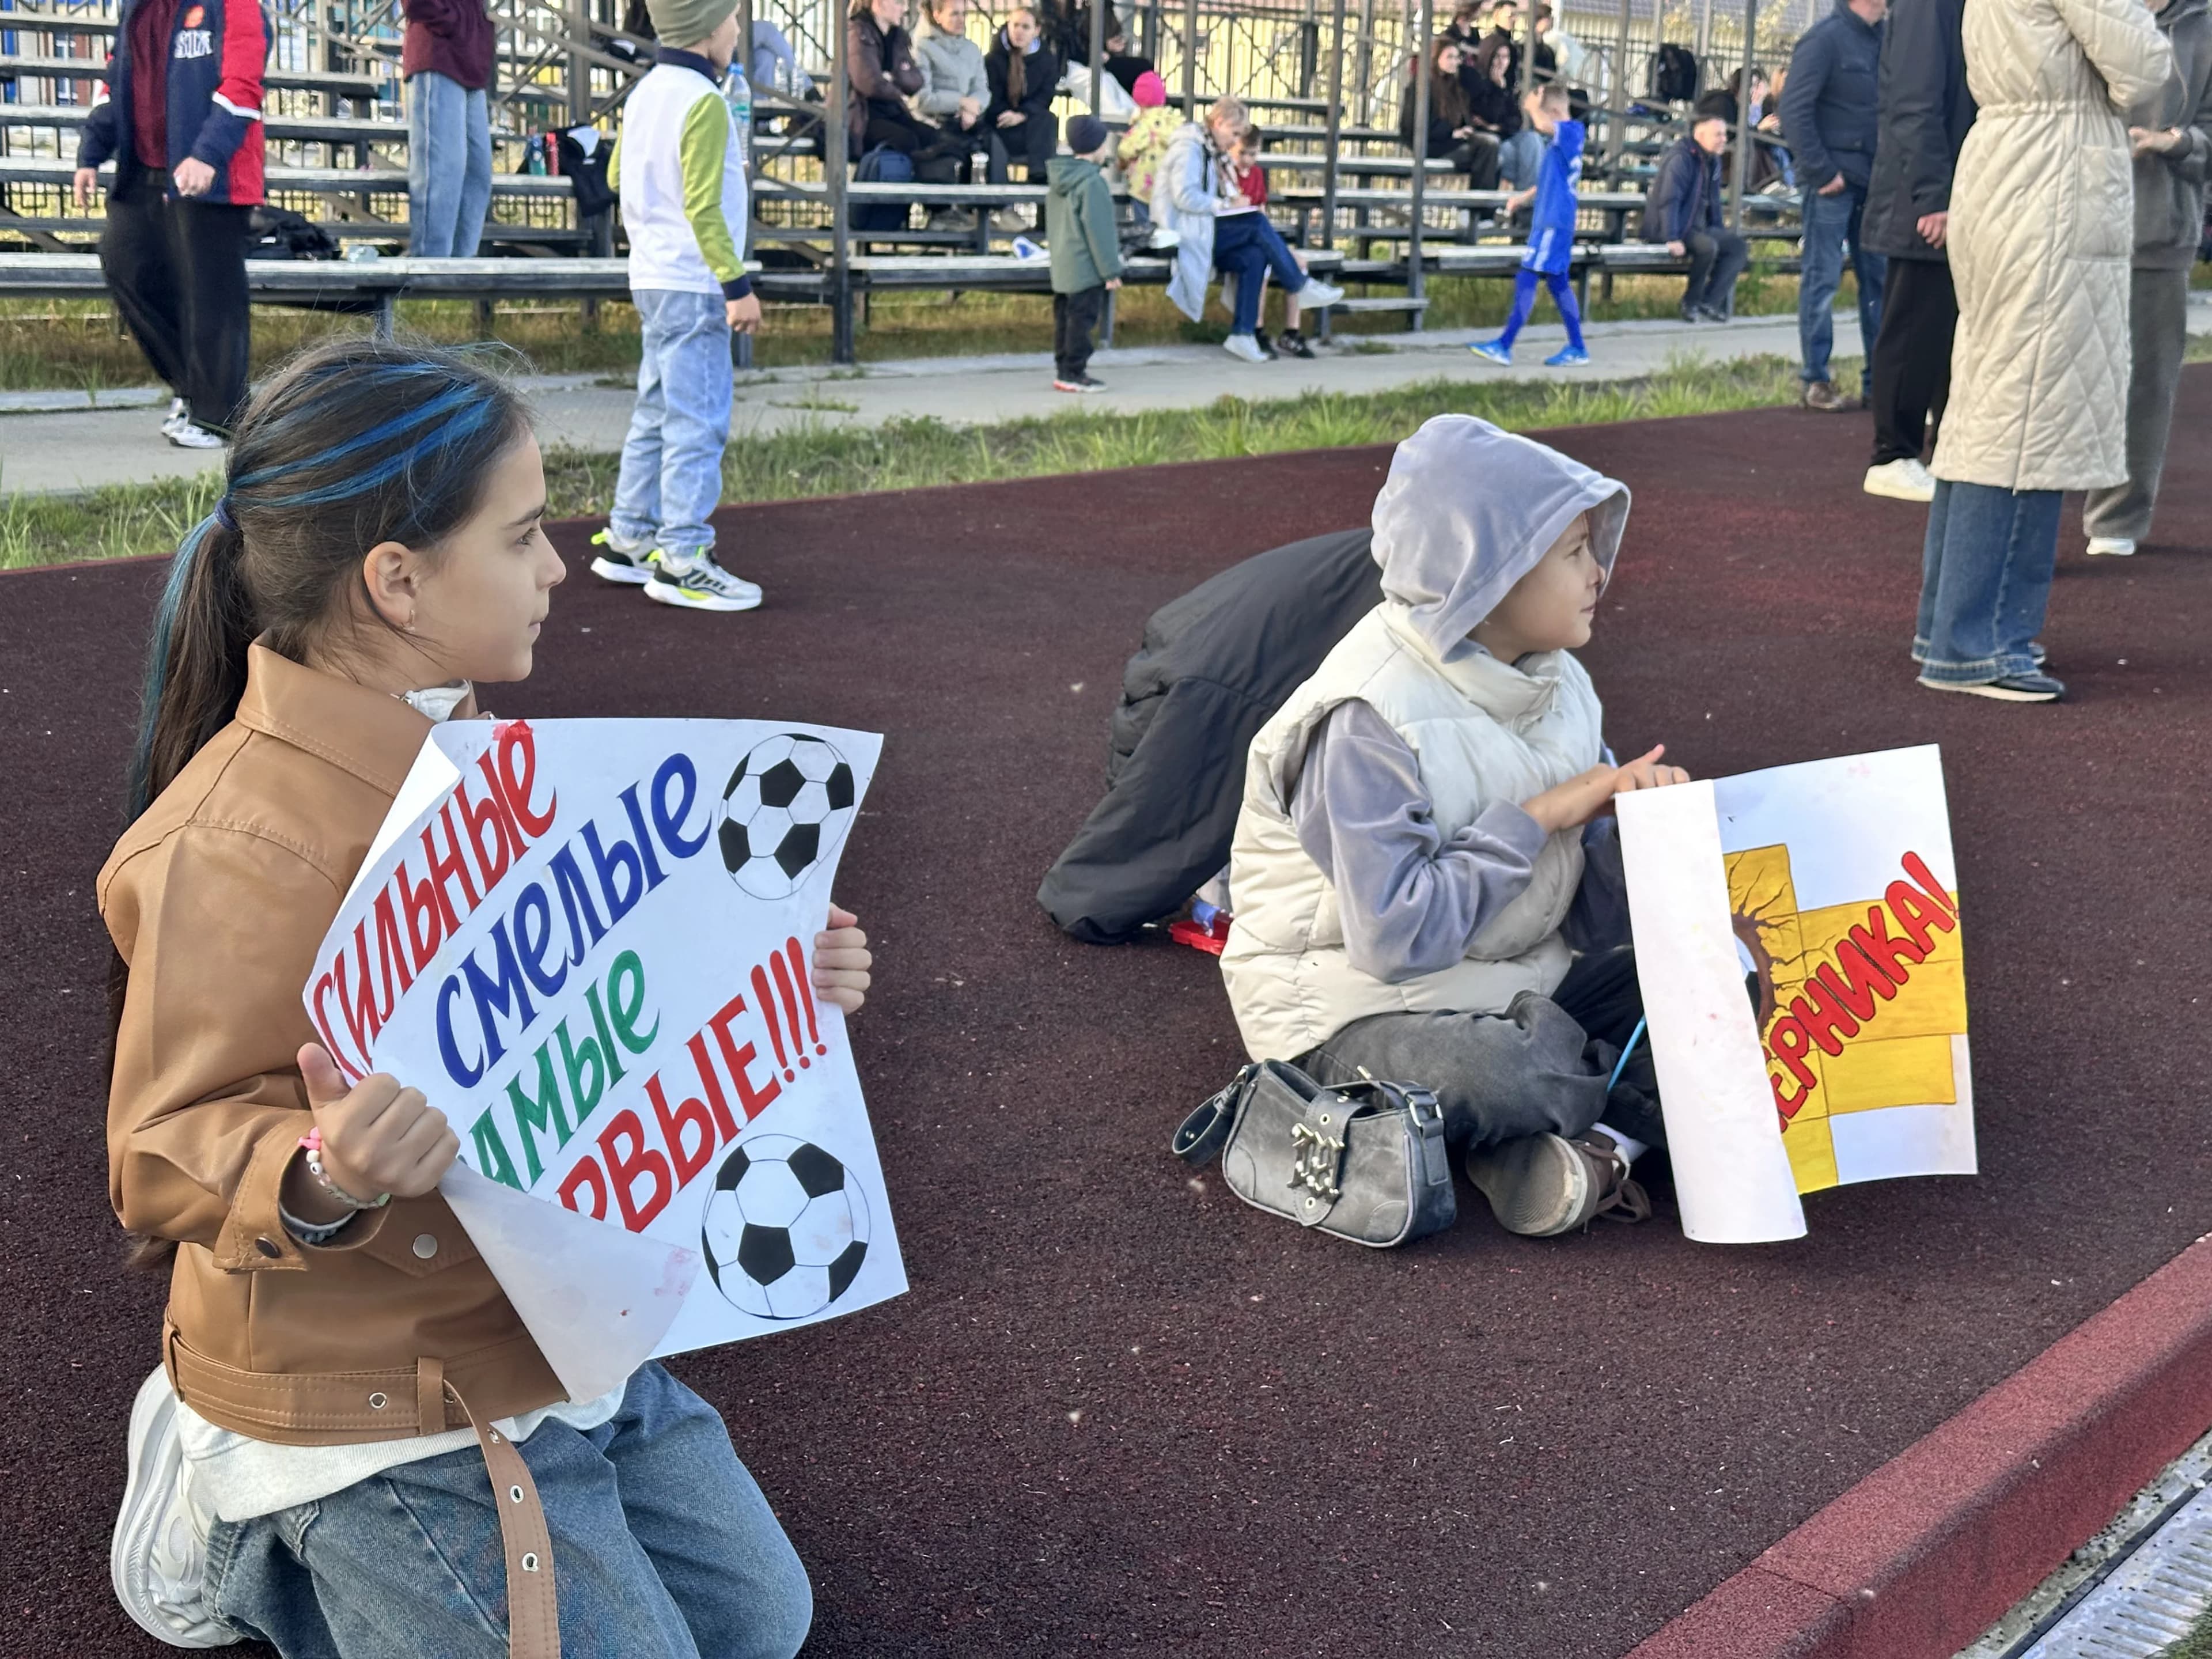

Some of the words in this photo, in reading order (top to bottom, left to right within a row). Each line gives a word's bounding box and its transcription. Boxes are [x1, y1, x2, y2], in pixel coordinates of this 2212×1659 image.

[457, 949, 660, 1194] АМЫЕ
[555, 936, 827, 1234] РВЫЕ!!!
[1763, 850, 1960, 1134] ЕРНИКА!
